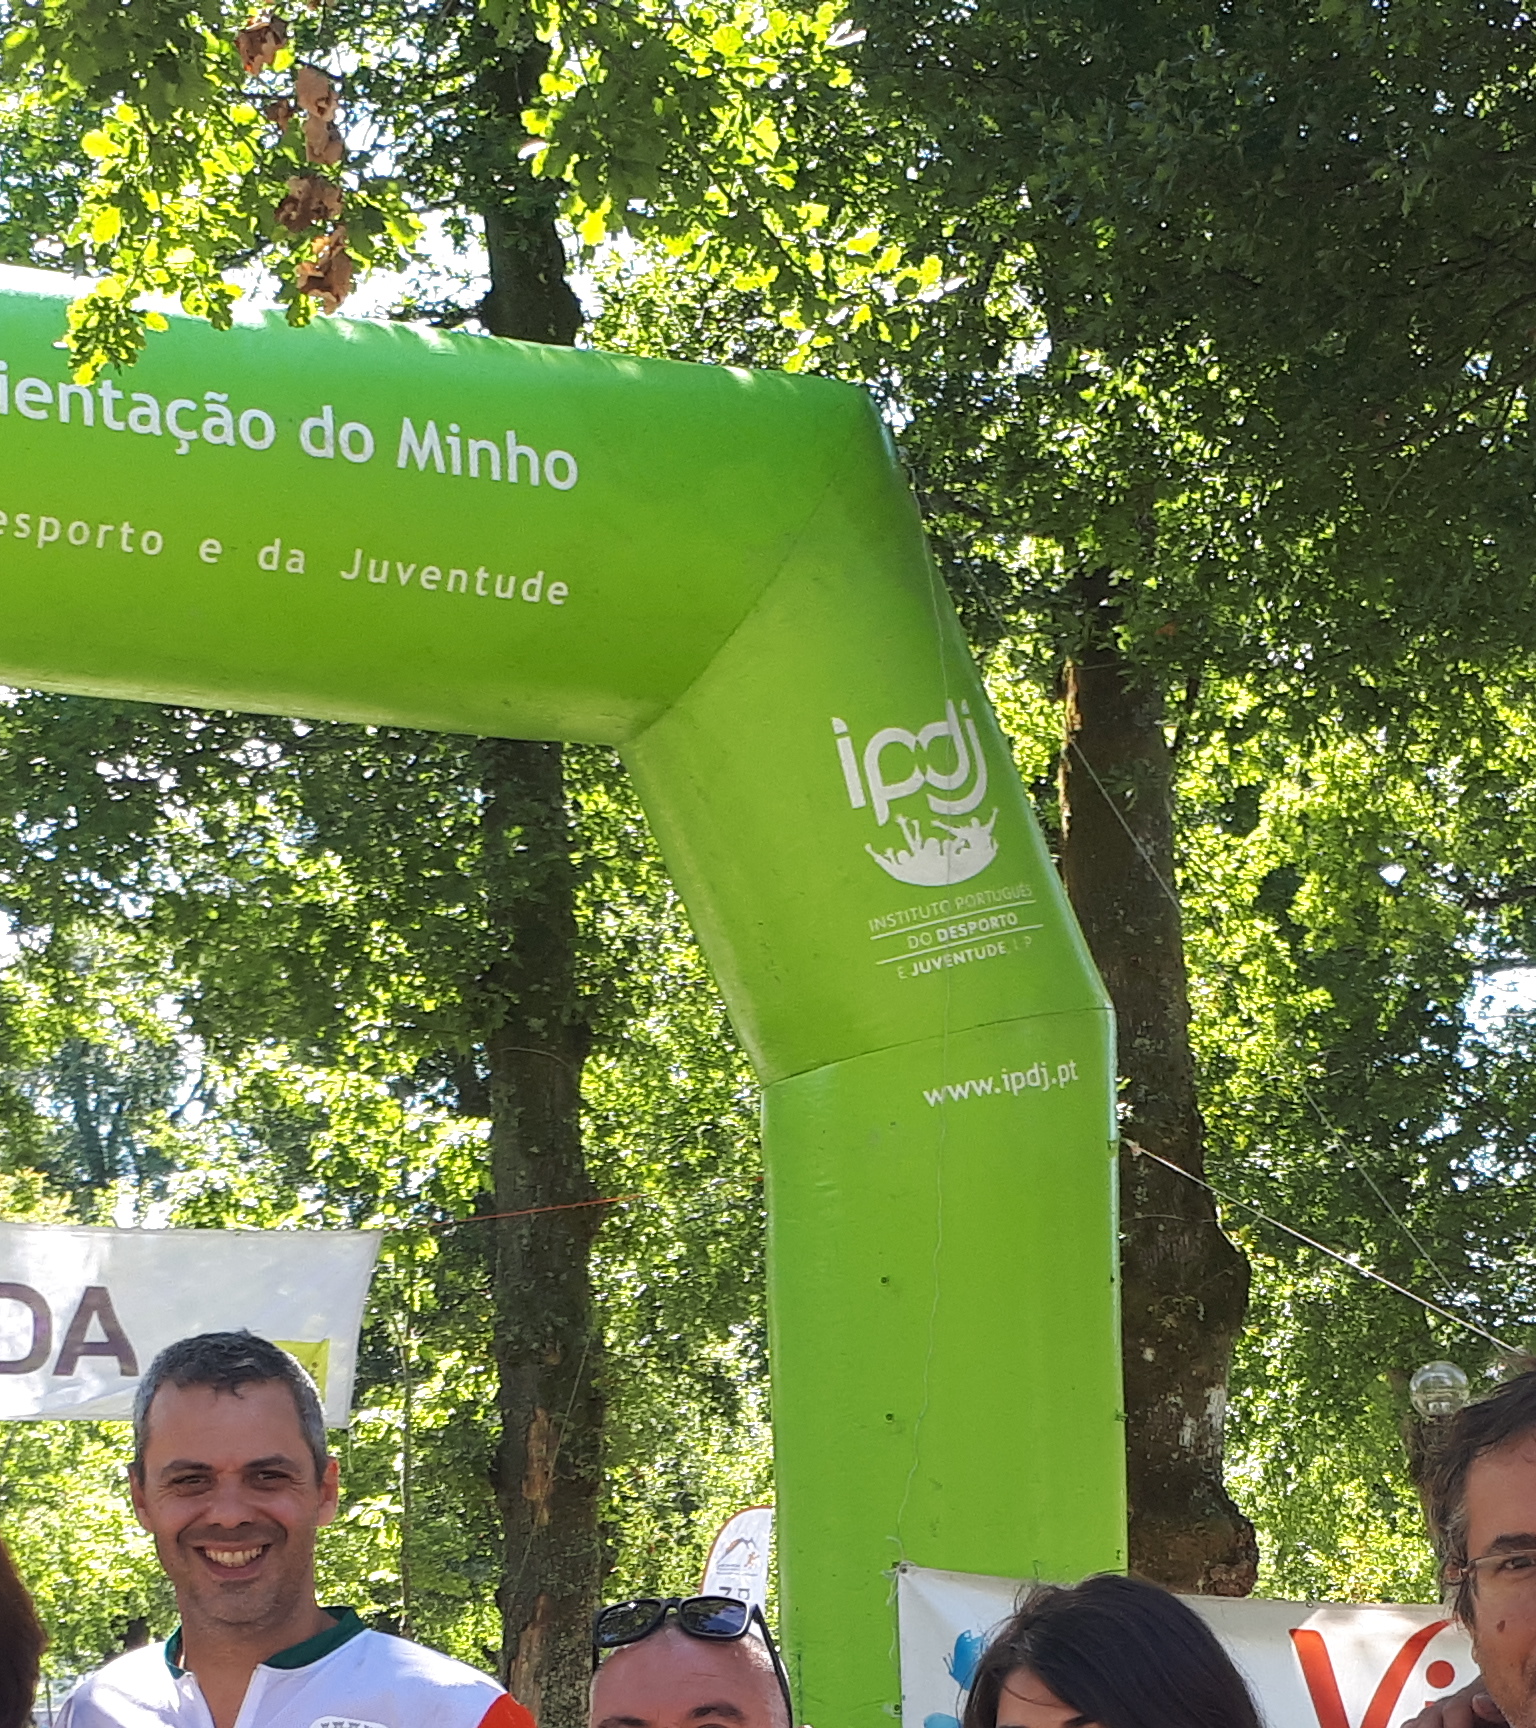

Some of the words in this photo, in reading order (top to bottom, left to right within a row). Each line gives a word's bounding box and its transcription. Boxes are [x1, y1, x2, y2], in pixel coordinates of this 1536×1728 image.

[299, 404, 375, 464] do
[396, 416, 579, 491] Minho
[198, 537, 223, 565] e
[257, 538, 307, 575] da
[340, 547, 571, 606] Juventude
[831, 699, 988, 826] ipdj
[868, 899, 950, 933] INSTITUTO
[955, 881, 1033, 911] PORTUGUÊS
[907, 931, 933, 951] DO
[936, 911, 1019, 943] DESPORTO
[897, 965, 908, 980] E
[922, 1058, 1079, 1108] www.ipdj.pt
